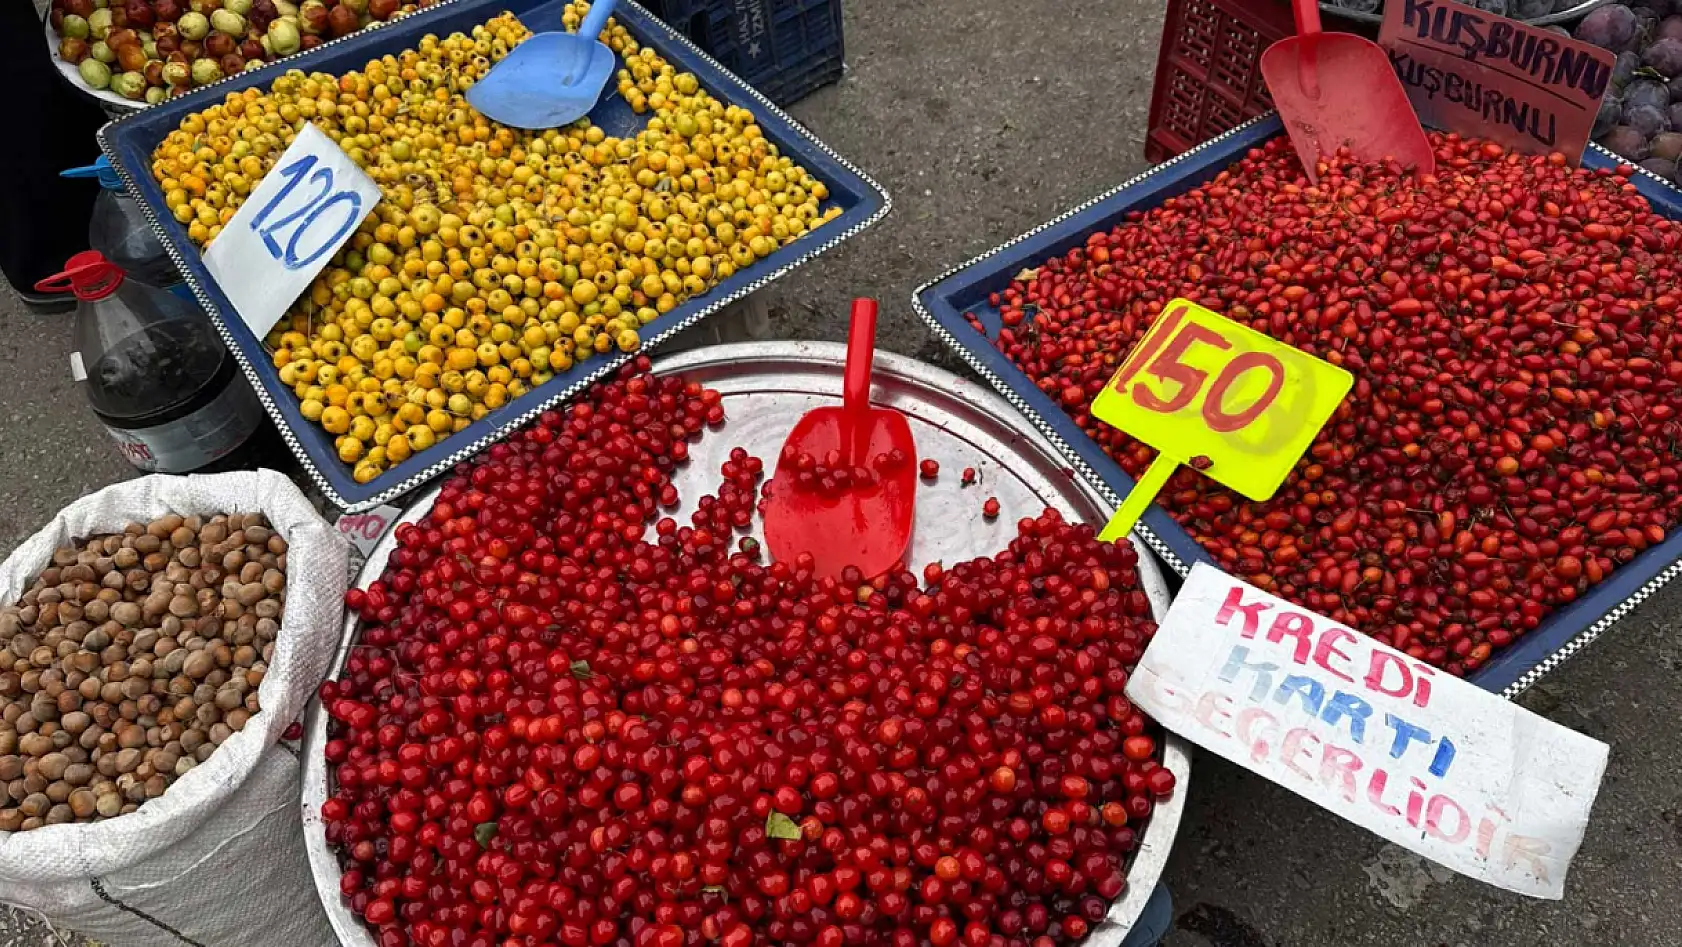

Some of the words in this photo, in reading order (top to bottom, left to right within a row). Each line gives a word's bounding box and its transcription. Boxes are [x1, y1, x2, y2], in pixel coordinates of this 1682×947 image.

[1388, 48, 1556, 147] KUŞBURNU
[1403, 0, 1612, 99] KUŞBURNU
[249, 154, 362, 270] 120
[1115, 305, 1285, 433] 150
[1214, 586, 1436, 708] KREDİ
[1217, 644, 1457, 780] KARTI
